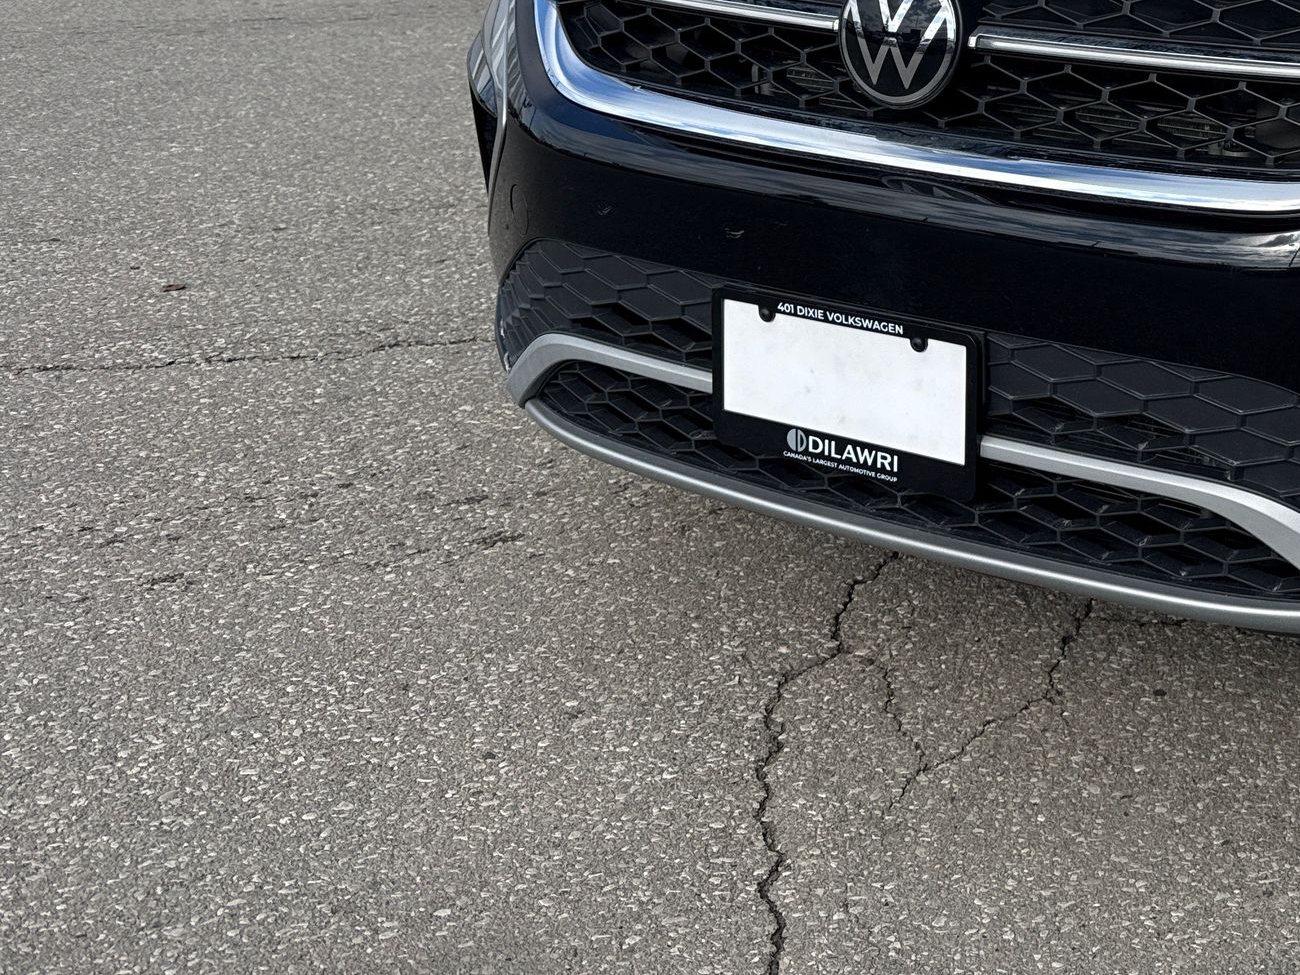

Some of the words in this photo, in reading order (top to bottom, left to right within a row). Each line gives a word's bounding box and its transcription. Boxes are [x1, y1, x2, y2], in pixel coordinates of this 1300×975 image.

[777, 302, 795, 314] 401
[796, 305, 825, 320] DIXIE
[826, 311, 904, 335] VOLKSWAGEN
[783, 450, 812, 462] CANADA'S
[812, 457, 838, 468] LARGEST
[838, 463, 876, 478] AUTOMOTIVE
[876, 472, 898, 482] GROUP
[808, 435, 899, 473] DILAWRI
